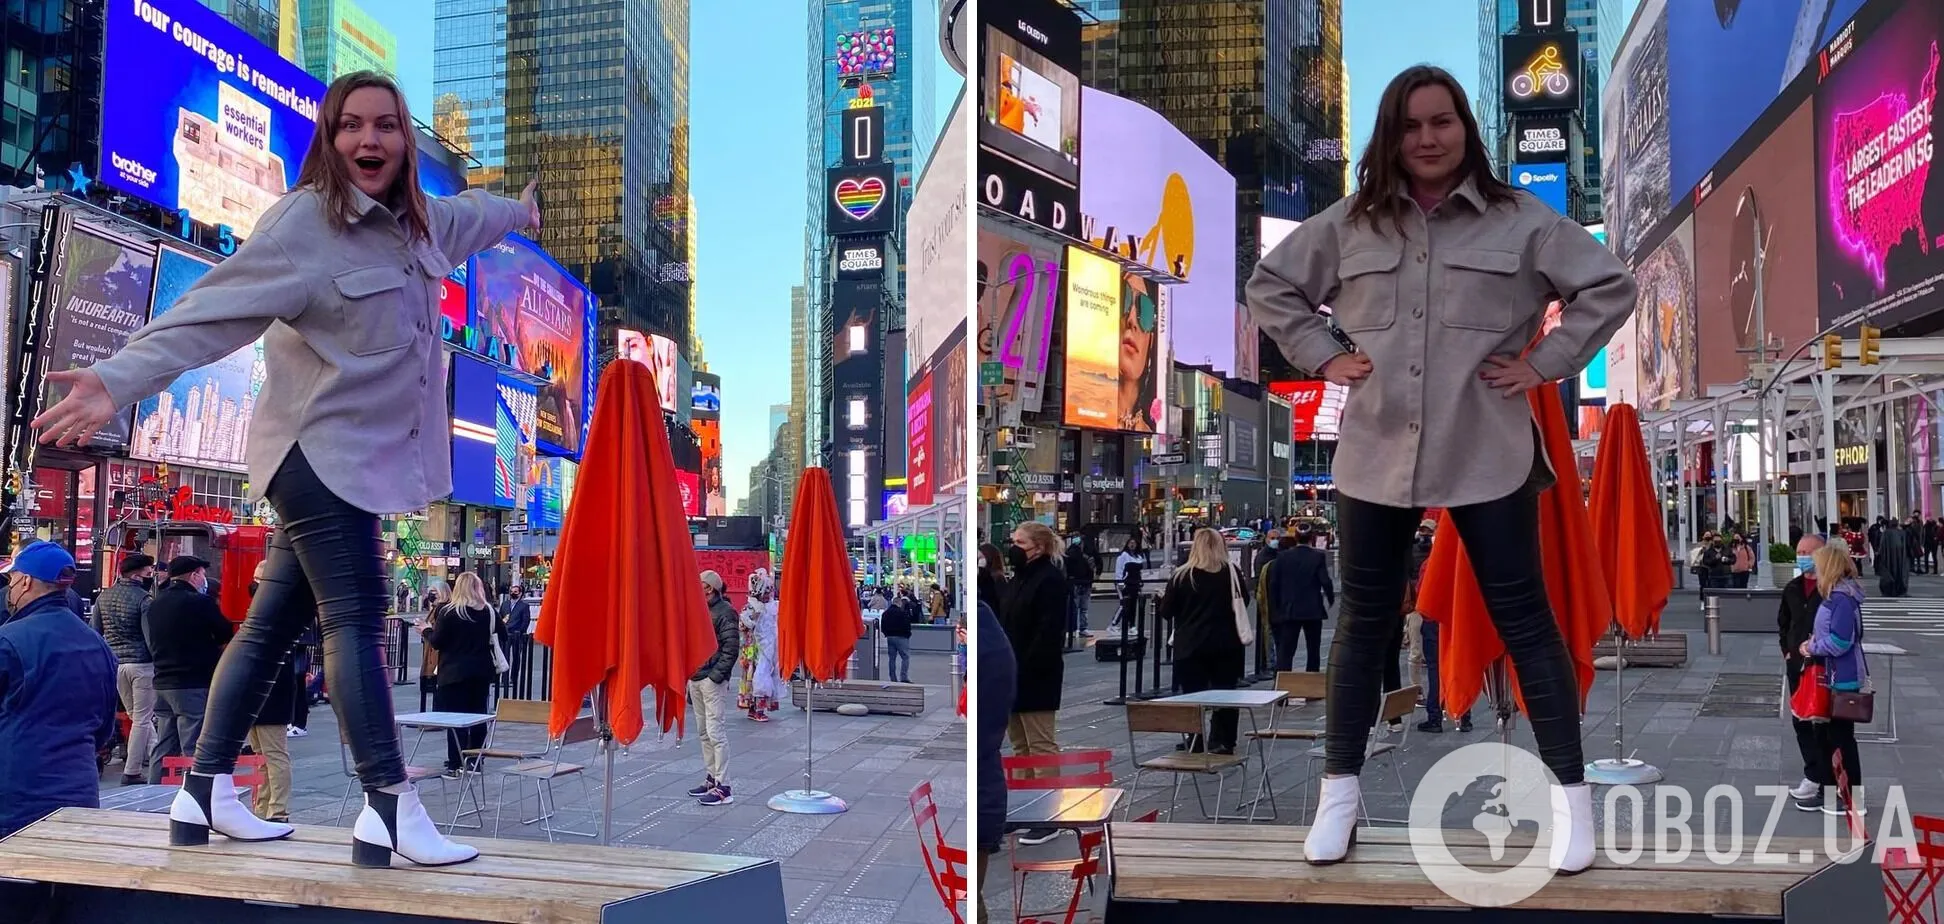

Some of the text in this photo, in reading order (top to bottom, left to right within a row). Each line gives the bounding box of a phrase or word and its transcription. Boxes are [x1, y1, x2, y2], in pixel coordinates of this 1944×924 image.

[1018, 19, 1048, 45] LG OLED TV
[1829, 20, 1855, 53] MARRIOTT
[133, 0, 320, 122] Your courage is remarkabl
[1829, 38, 1853, 67] MARQUIS
[849, 98, 874, 109] 2021
[224, 104, 266, 136] essential
[1628, 79, 1662, 158] WHALES
[226, 121, 264, 151] workers
[1519, 139, 1566, 152] SQUARE
[1525, 129, 1560, 141] TIMES
[1846, 98, 1932, 181] LARGEST. FASTEST.
[112, 152, 157, 183] brother
[119, 171, 127, 179] at
[1533, 174, 1558, 184] Spotify
[1848, 132, 1933, 212] THE LEADER IN 5G
[840, 258, 882, 270] SQUARE
[844, 249, 877, 260] TIMES
[66, 295, 140, 327] INSUREARTH
[545, 299, 572, 336] STARS
[1000, 253, 1059, 373] 21
[94, 323, 107, 331] real
[107, 327, 130, 336] compan
[71, 352, 88, 360] great
[1834, 444, 1869, 466] EPHORA
[1092, 476, 1124, 491] sunglass hut
